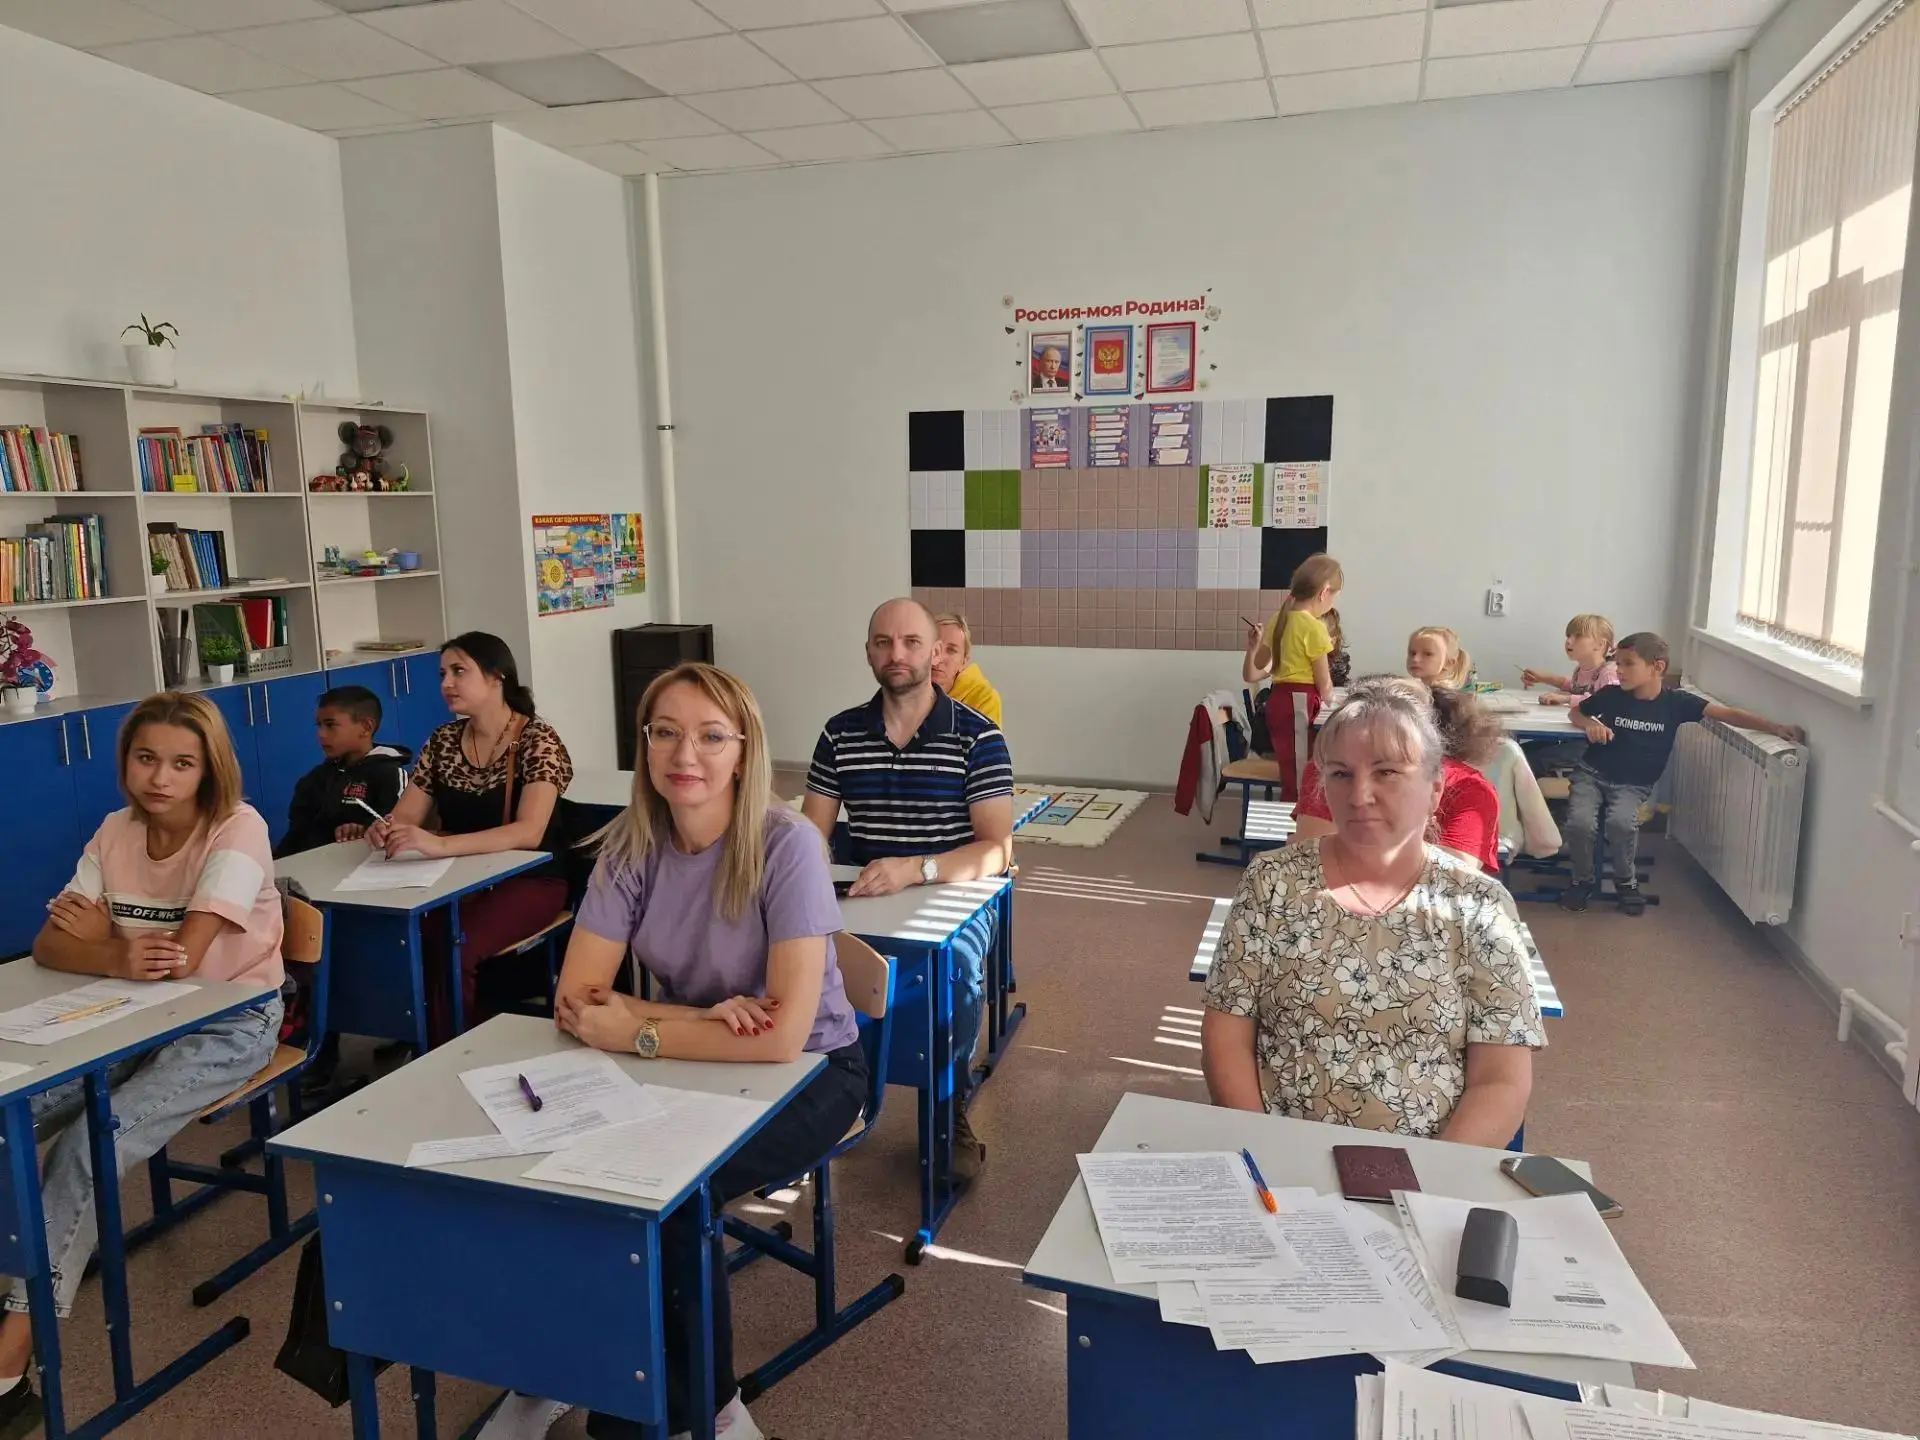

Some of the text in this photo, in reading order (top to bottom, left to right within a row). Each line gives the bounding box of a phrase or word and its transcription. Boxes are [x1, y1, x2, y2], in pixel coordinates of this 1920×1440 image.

[1015, 296, 1205, 323] Россия-моя Родина!
[1614, 716, 1665, 733] EKINBROWN
